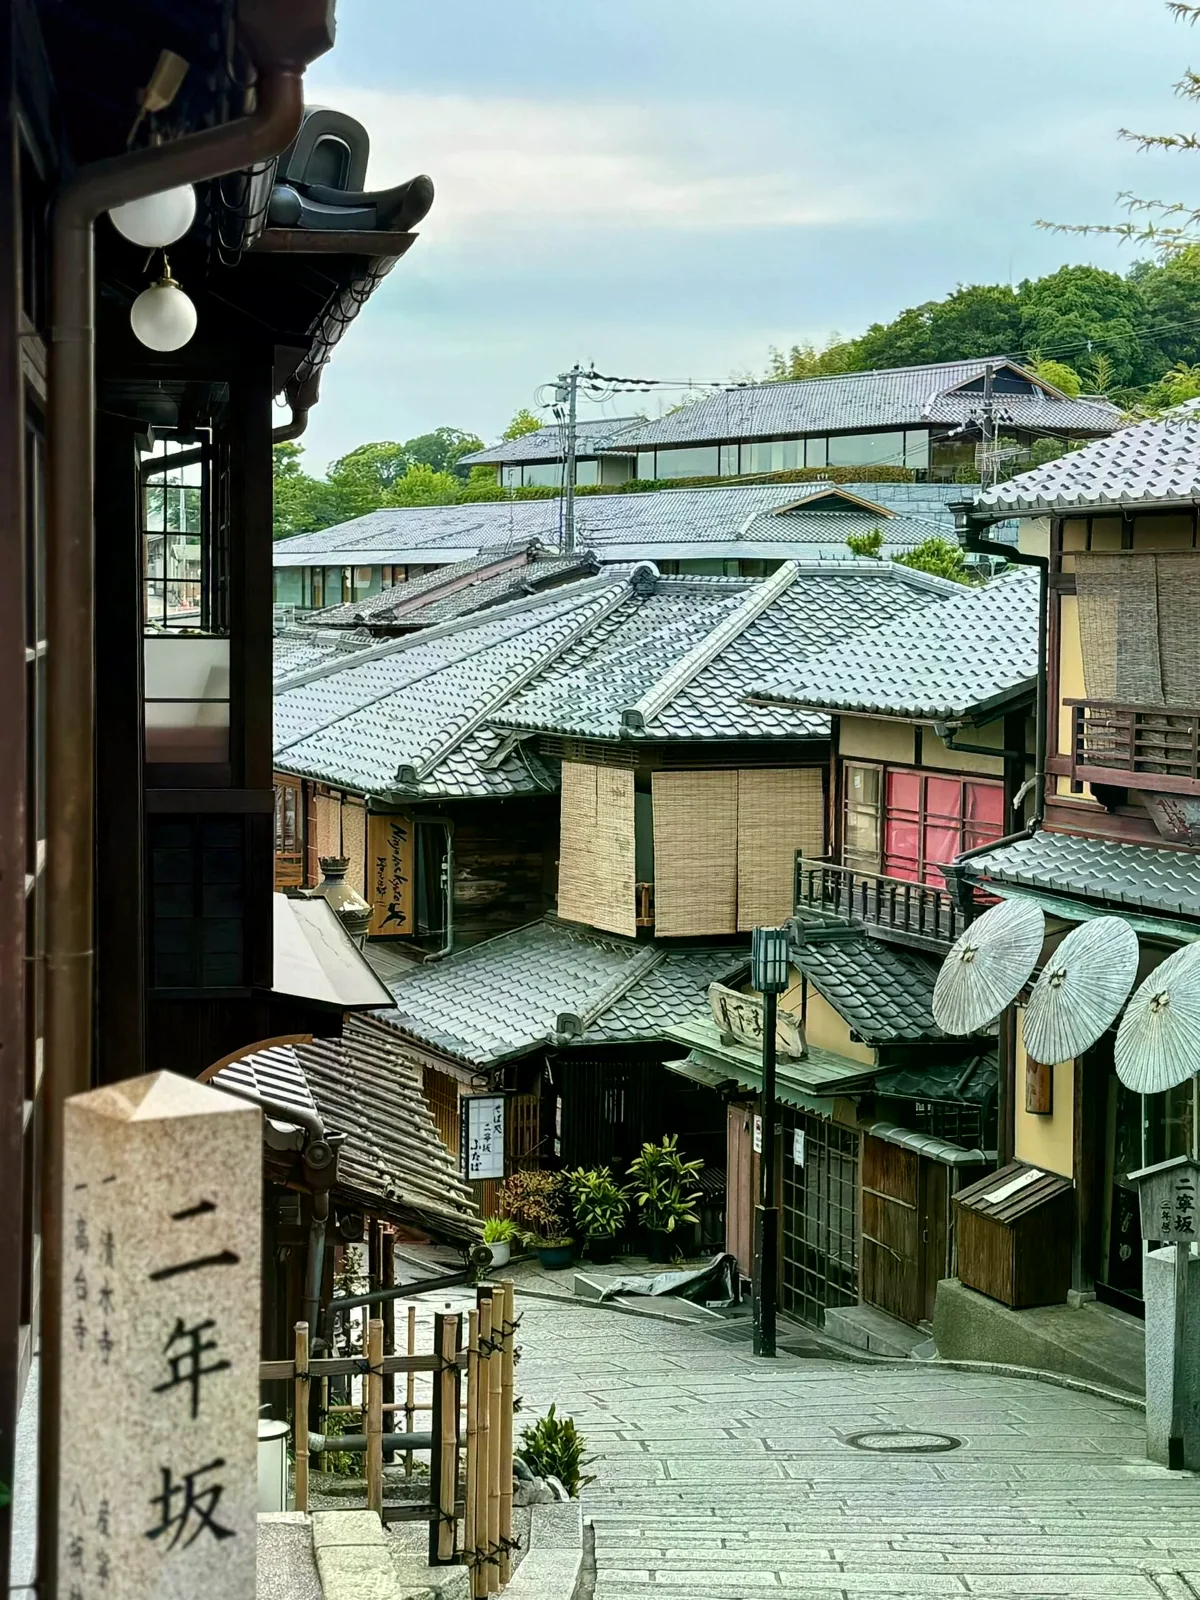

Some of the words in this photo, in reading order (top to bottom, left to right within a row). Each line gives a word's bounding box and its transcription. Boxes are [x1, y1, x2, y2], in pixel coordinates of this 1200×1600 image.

[470, 1139, 482, 1171] ふたば
[1174, 1178, 1195, 1233] 二寧坂
[145, 1199, 240, 1552] 二年坂
